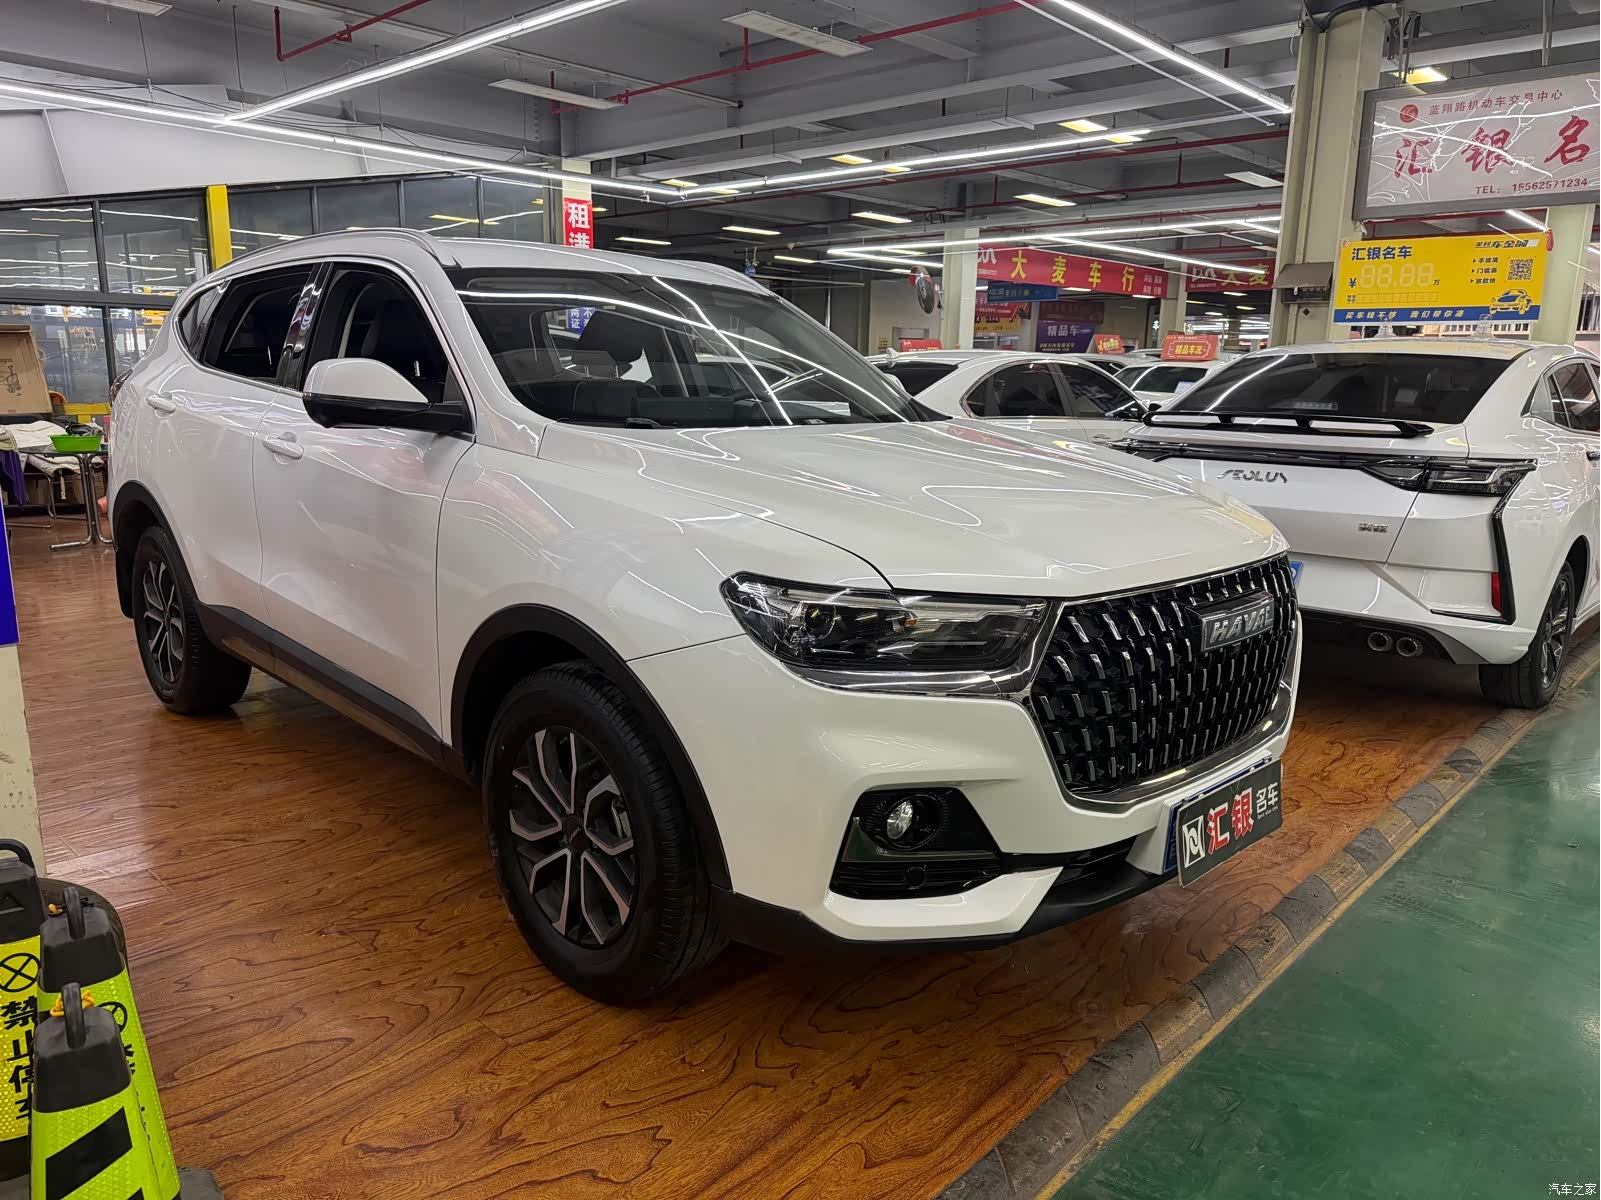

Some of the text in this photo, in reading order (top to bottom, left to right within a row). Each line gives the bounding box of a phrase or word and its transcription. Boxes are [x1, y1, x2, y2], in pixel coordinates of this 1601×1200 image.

[1428, 89, 1563, 116] 蓝翔路机动车交易中心
[1511, 178, 1589, 193] 15562571234
[1351, 245, 1413, 261] 汇银名车
[1010, 250, 1135, 292] 大麦车行
[1047, 325, 1080, 337] 精品车
[1209, 605, 1273, 644] HAVAL
